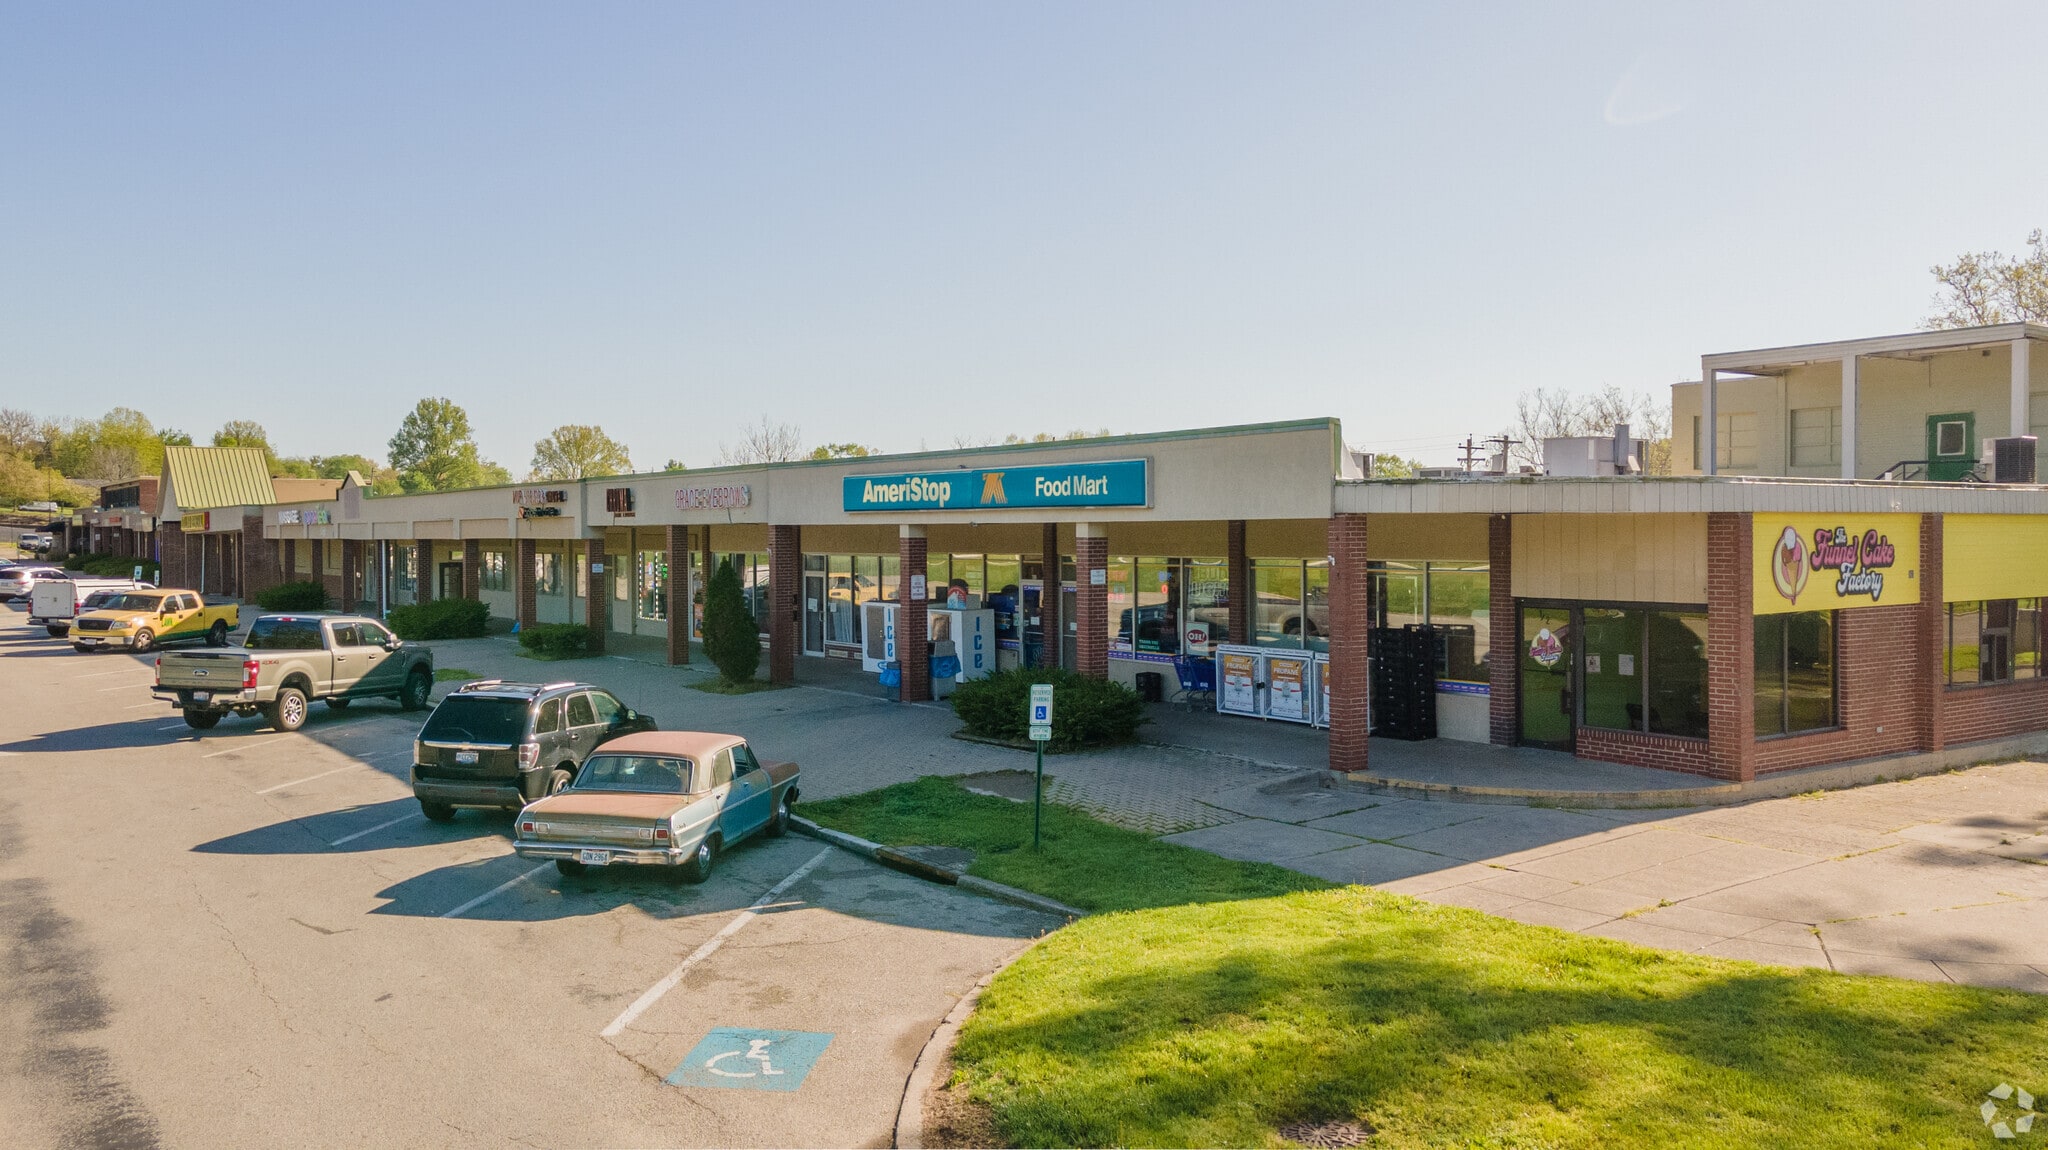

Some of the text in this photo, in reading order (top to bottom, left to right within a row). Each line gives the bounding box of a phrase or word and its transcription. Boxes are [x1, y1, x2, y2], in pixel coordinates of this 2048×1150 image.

[675, 485, 750, 510] GRACE EYEBROWS
[862, 477, 951, 508] AmeriStop
[1035, 474, 1108, 497] Food Mart
[1835, 527, 1847, 544] The
[1811, 528, 1895, 569] Funnel Cake
[1837, 561, 1883, 600] Factory
[1226, 662, 1250, 670] PROPANE
[1273, 667, 1299, 676] PROPANE
